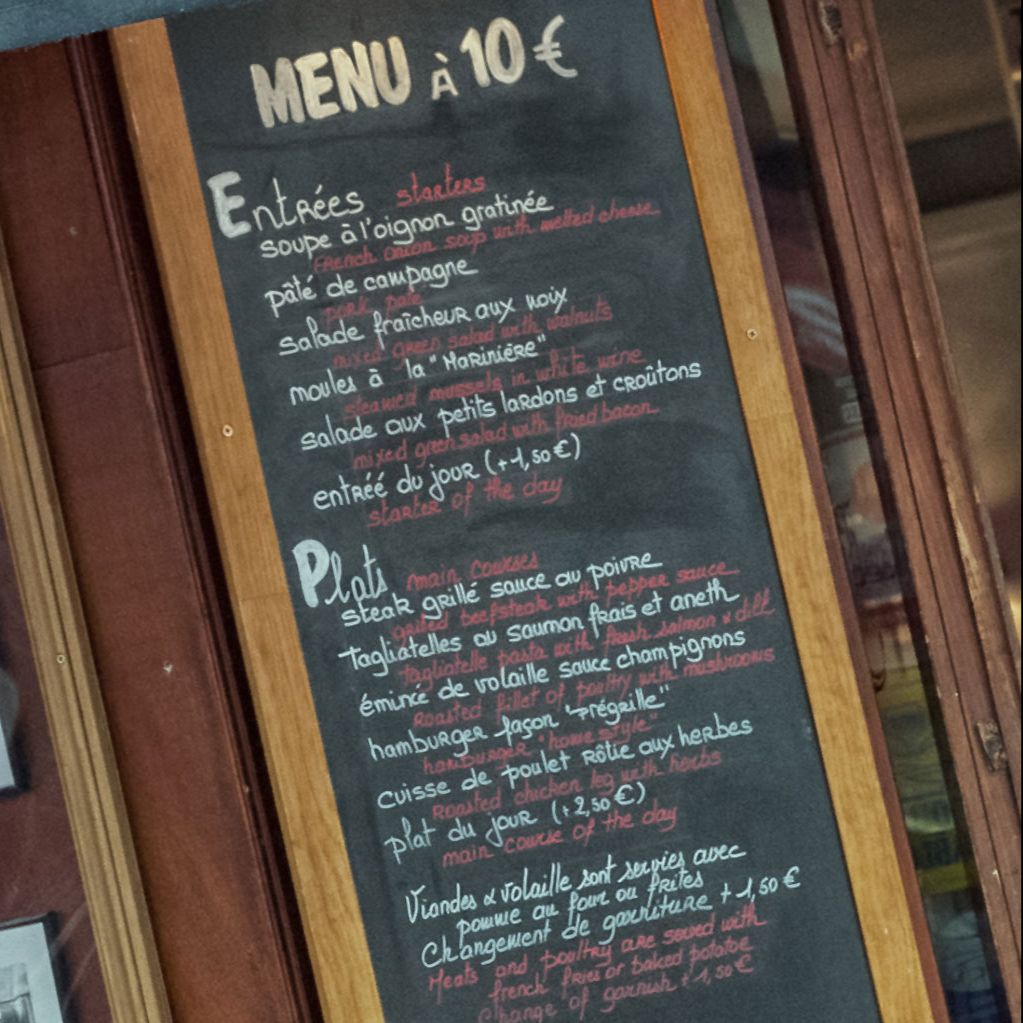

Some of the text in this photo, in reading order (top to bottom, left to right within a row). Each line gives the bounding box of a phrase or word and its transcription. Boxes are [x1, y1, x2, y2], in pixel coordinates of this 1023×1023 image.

[249, 36, 411, 128] MENU
[460, 16, 525, 87] 10
[533, 14, 578, 77] €
[207, 163, 485, 238] Entrées starters
[260, 190, 554, 260] soupe à l'oignon gratinée
[443, 229, 488, 257] soup
[493, 214, 534, 240] with
[540, 203, 594, 231] melted
[597, 198, 661, 224] cheese
[264, 259, 479, 319] pâté de campagne
[278, 285, 568, 356] salade fraîcheur aux noix
[332, 343, 385, 371] mixed
[447, 320, 495, 349] salad
[501, 312, 543, 338] with
[547, 294, 613, 330] walnuts
[289, 367, 357, 406] moules
[368, 368, 384, 388] à
[405, 358, 426, 379] la
[300, 359, 702, 451] salade aux petits lardons et croûtons
[344, 345, 647, 420] steamed mussels in white wine
[352, 438, 408, 470] mixed
[459, 421, 508, 446] salad
[512, 411, 549, 435] with
[601, 400, 660, 424] bacon
[368, 472, 564, 528] starter of the day
[396, 463, 423, 494] du
[429, 462, 480, 502] jour
[292, 539, 539, 608] Plats main courses
[341, 552, 663, 627] steak grillé sauce au poivre
[460, 594, 552, 626] beefsteak
[558, 579, 599, 607] with
[605, 572, 671, 608] pepper
[677, 561, 740, 583] sauce
[337, 577, 741, 677] Tagliatelles au saumon frais et aneth
[496, 639, 549, 668] pasta
[553, 628, 594, 657] with
[652, 612, 718, 639] salmon
[359, 630, 746, 717] émincé de volaille sauce champignons
[545, 682, 565, 713] of
[639, 663, 680, 687] with
[682, 647, 775, 677] mushrooms
[367, 725, 489, 762] hamburger
[494, 713, 560, 747] façon
[461, 767, 493, 791] de
[500, 749, 571, 790] poulet
[638, 733, 676, 760] aux
[677, 712, 754, 747] herbes
[514, 776, 585, 807] chicken
[590, 768, 616, 797] leg
[619, 759, 665, 783] with
[668, 747, 722, 774] herbs
[384, 816, 436, 865] plat
[447, 816, 477, 843] du
[485, 810, 539, 849] jour
[442, 798, 677, 868] main course of the day
[405, 882, 478, 924] Viandes
[500, 862, 573, 904] volaille
[576, 854, 617, 891] sont
[617, 850, 686, 884] servies
[692, 844, 747, 866] avec
[456, 866, 704, 950] pomme au four ou frites
[421, 919, 553, 969] Changement
[561, 912, 591, 941] de
[597, 894, 713, 945] garniture
[429, 903, 769, 1006] Meats and poultry are served with
[487, 971, 549, 1008] french
[605, 963, 626, 979] or
[630, 947, 684, 976] baked
[568, 986, 589, 1021] of
